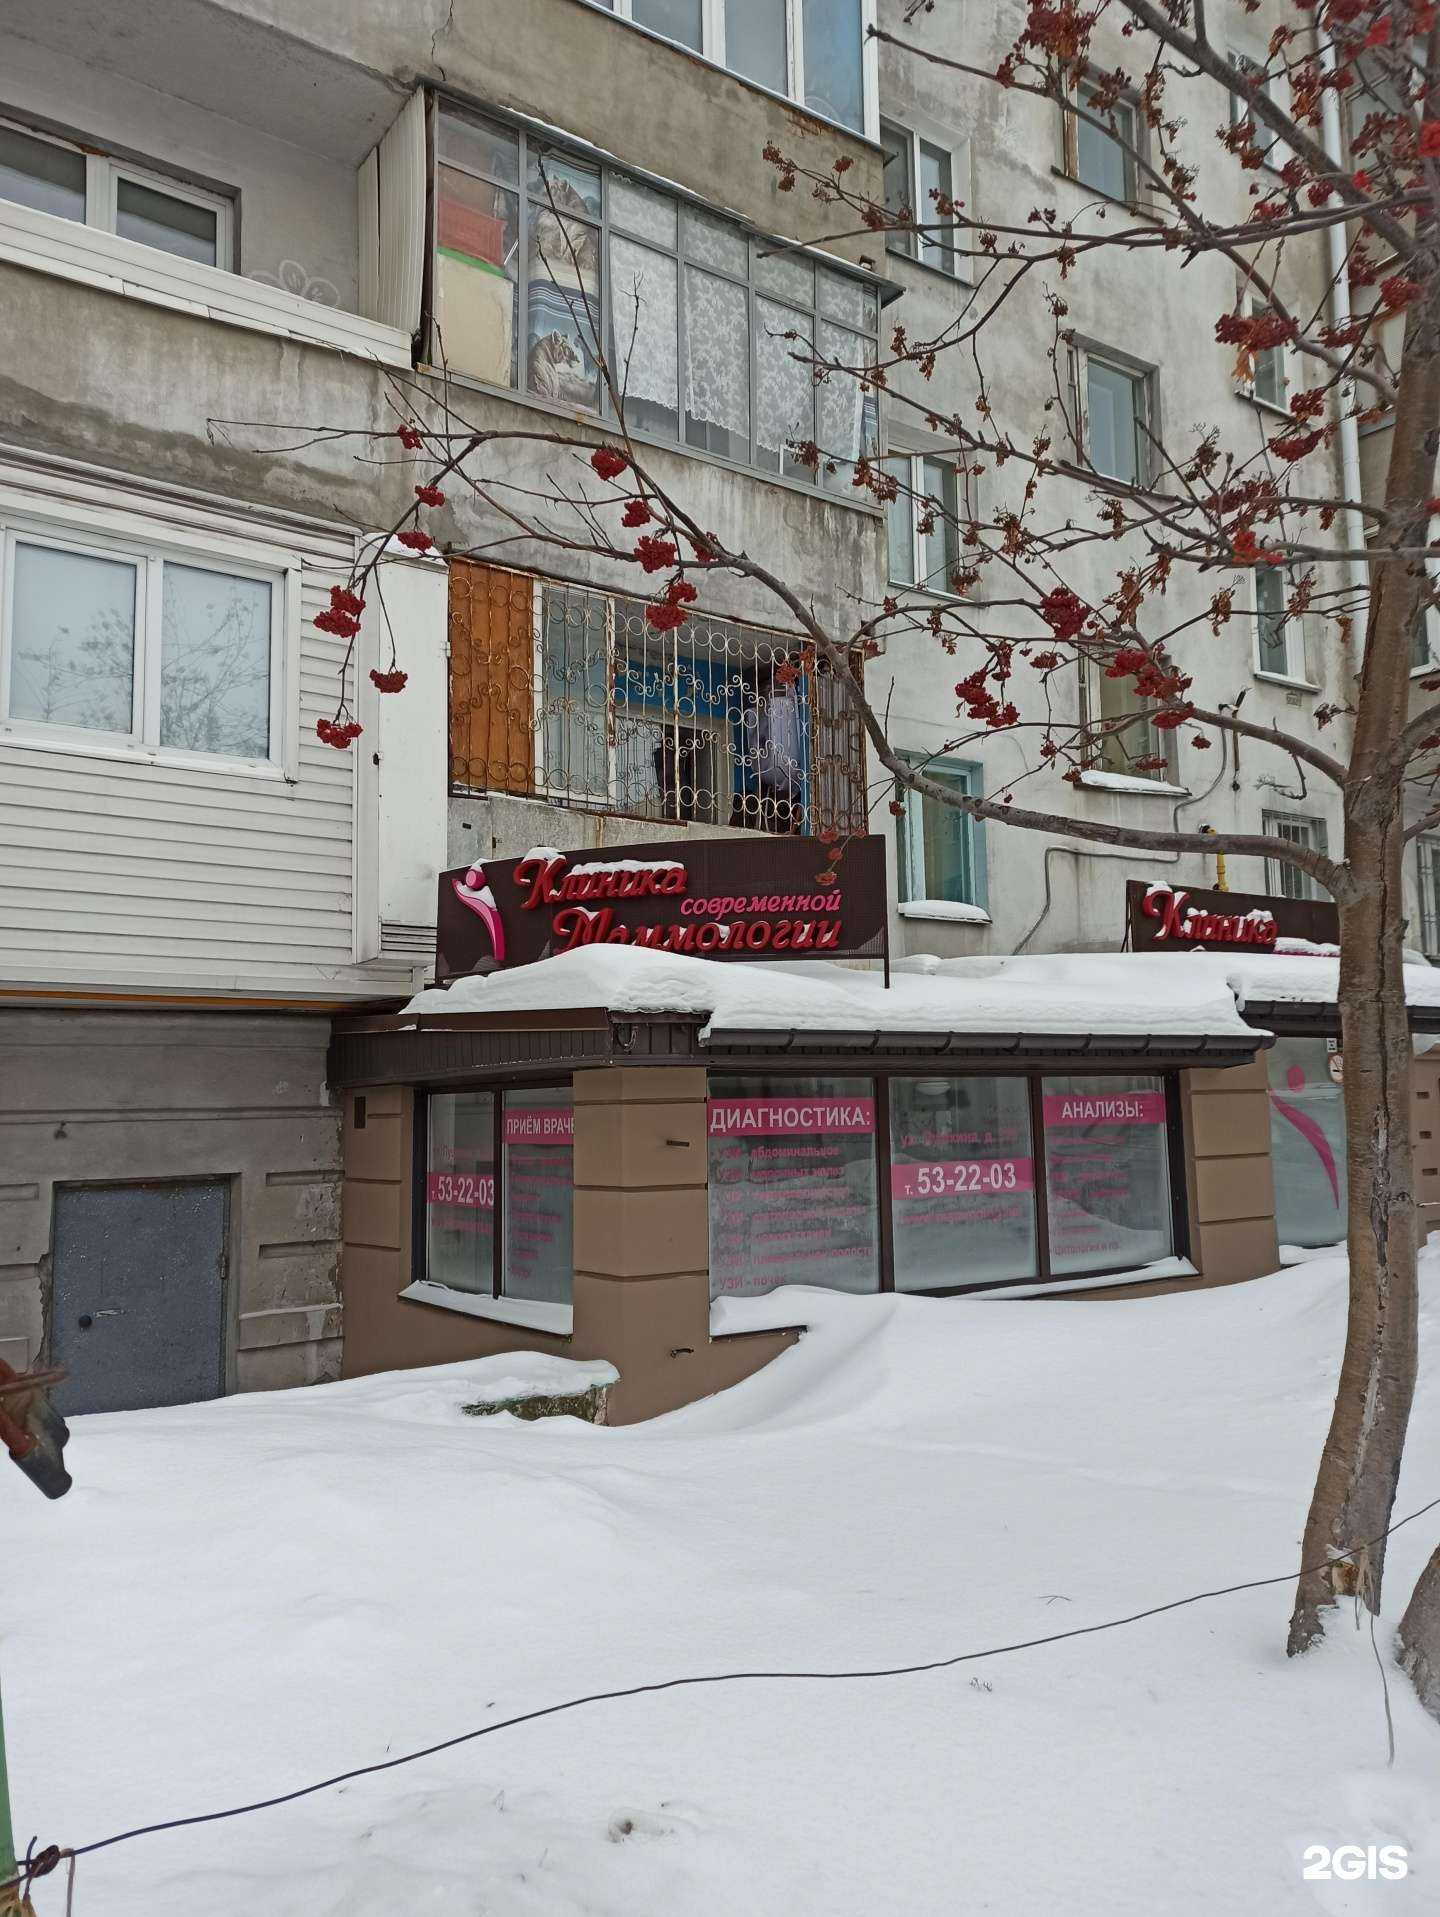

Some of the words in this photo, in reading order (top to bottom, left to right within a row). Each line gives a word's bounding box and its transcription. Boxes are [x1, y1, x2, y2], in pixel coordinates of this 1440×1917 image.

[513, 857, 688, 909] Клиника
[680, 889, 842, 921] современной
[710, 1107, 871, 1133] ДИАГНОСТИКА:
[1061, 1100, 1144, 1119] АНАЛИЗЫ:
[506, 1115, 541, 1135] ПРИЁМ
[438, 1176, 494, 1206] 53-22-03
[904, 1185, 914, 1196] т.
[917, 1162, 1017, 1195] 53-22-03
